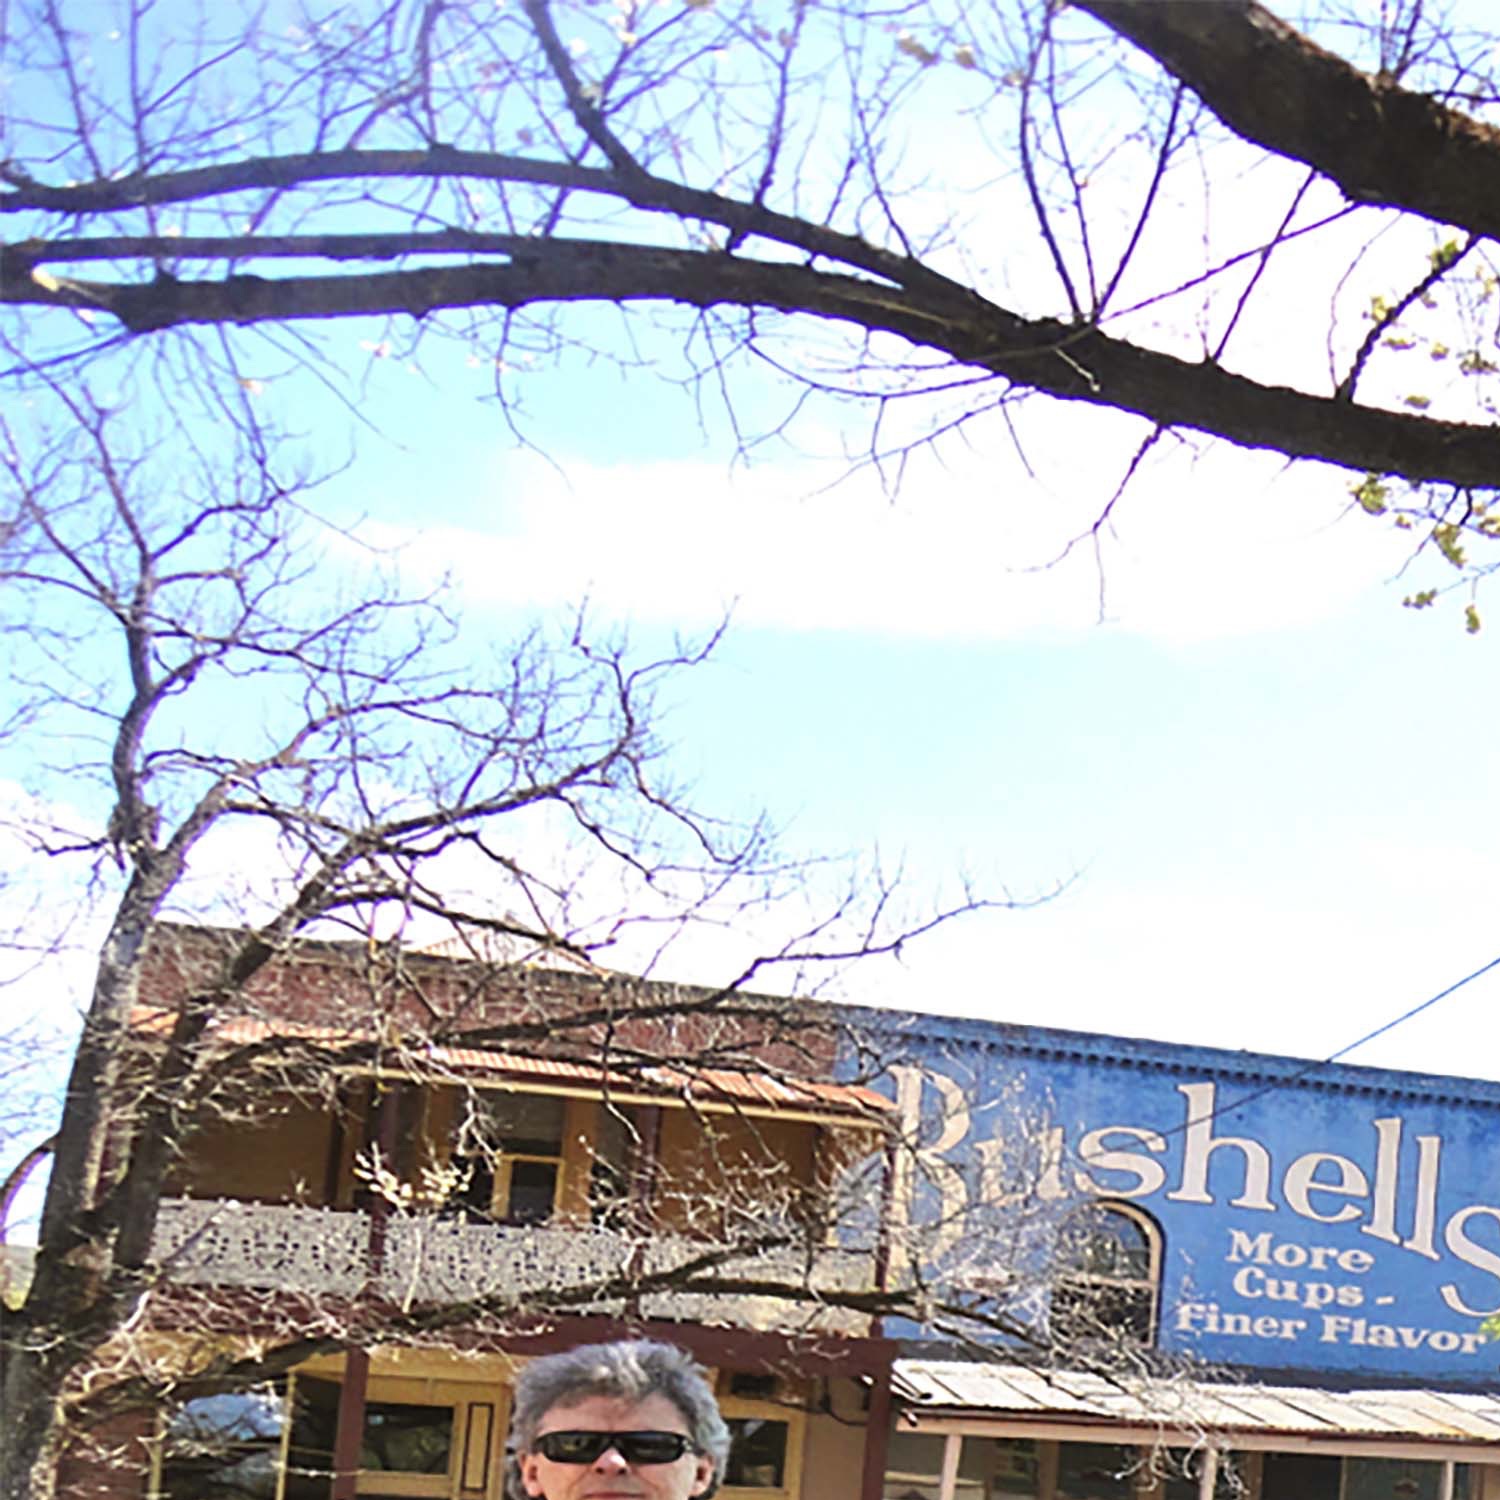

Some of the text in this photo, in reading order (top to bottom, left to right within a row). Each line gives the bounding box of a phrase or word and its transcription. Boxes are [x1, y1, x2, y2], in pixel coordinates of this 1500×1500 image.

[1224, 1227, 1376, 1274] More
[1174, 1303, 1488, 1354] Finer Flavor
